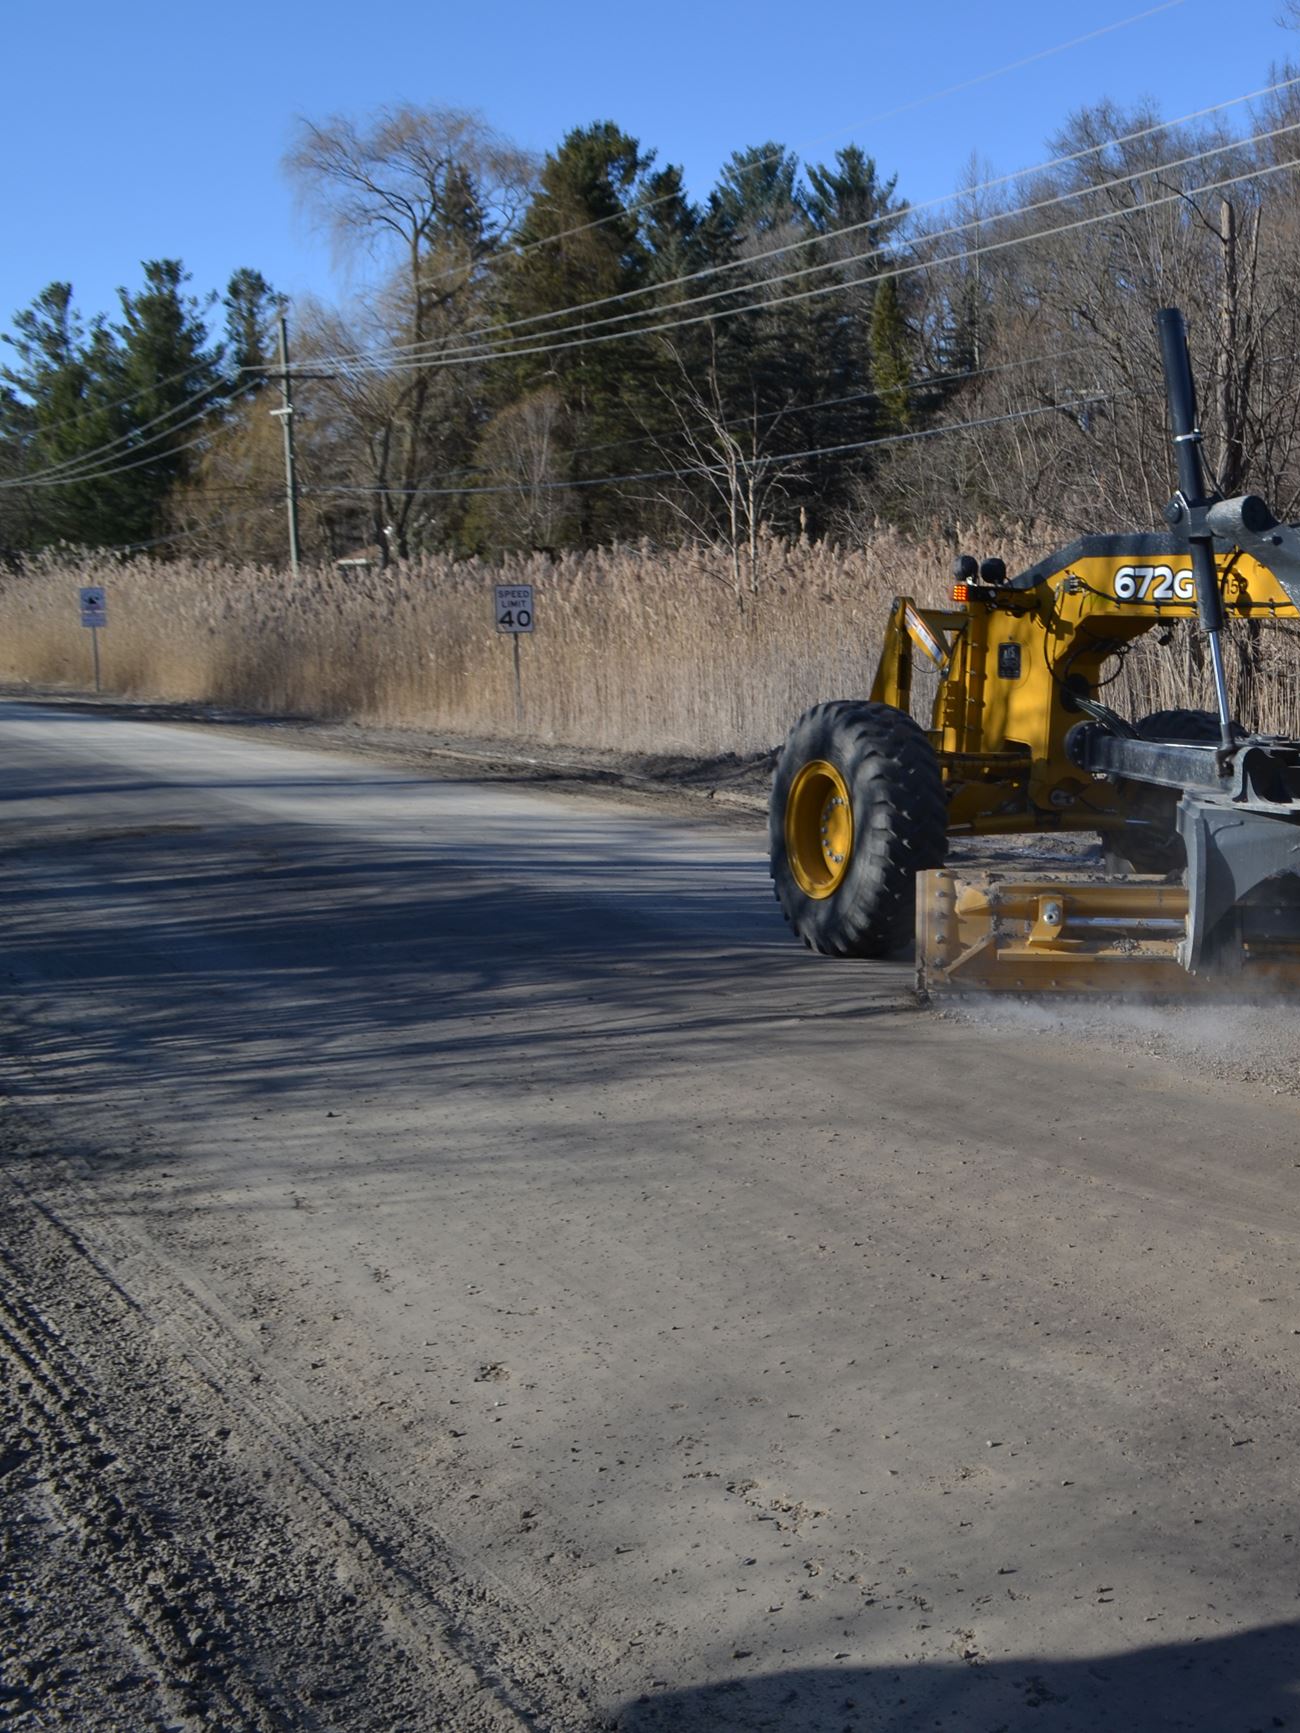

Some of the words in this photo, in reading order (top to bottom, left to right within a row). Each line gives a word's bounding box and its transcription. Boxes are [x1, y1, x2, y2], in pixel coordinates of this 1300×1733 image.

[1114, 566, 1194, 599] 672G
[498, 590, 529, 598] SPEED
[501, 600, 527, 608] LIMIT
[499, 610, 531, 627] 40
